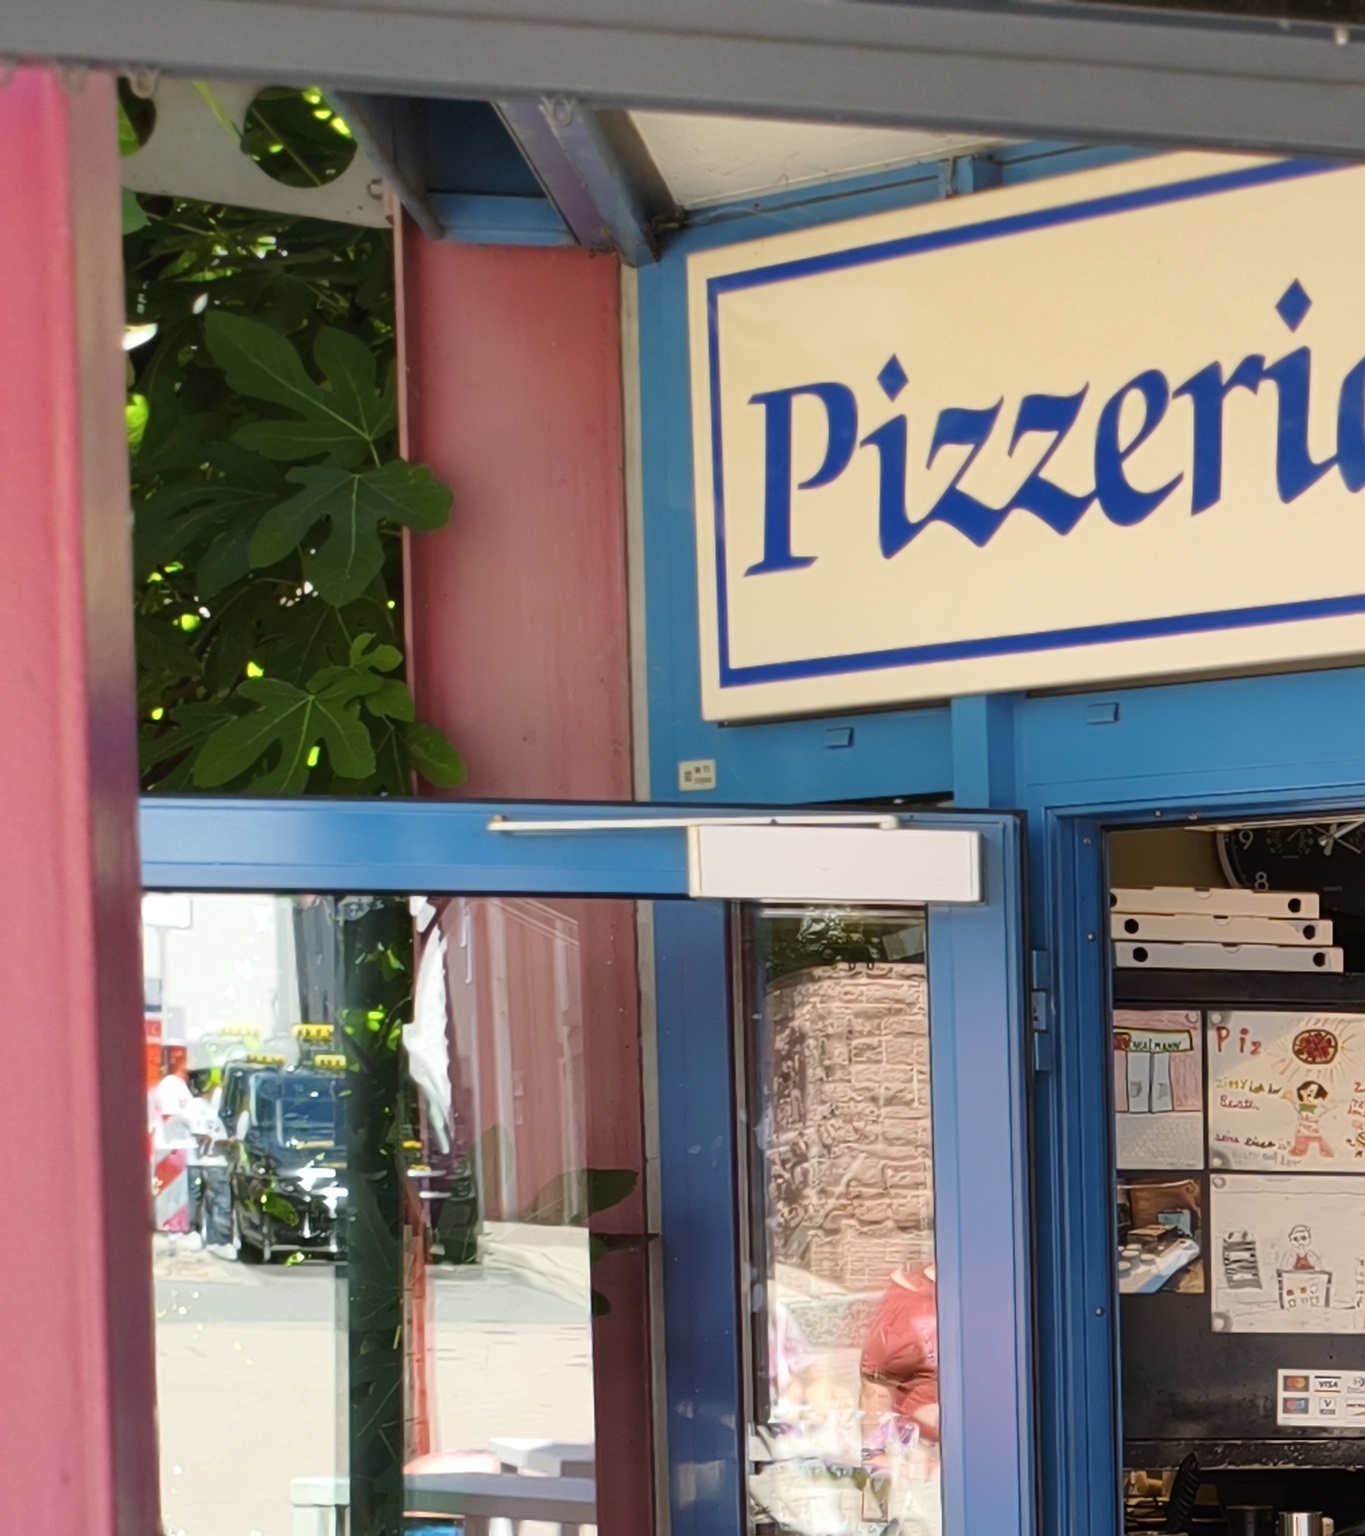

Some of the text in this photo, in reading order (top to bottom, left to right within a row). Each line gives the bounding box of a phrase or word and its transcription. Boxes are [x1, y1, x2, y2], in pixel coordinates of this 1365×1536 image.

[1239, 829, 1254, 851] 9
[1254, 871, 1269, 889] 8
[1318, 1380, 1339, 1389] VISA
